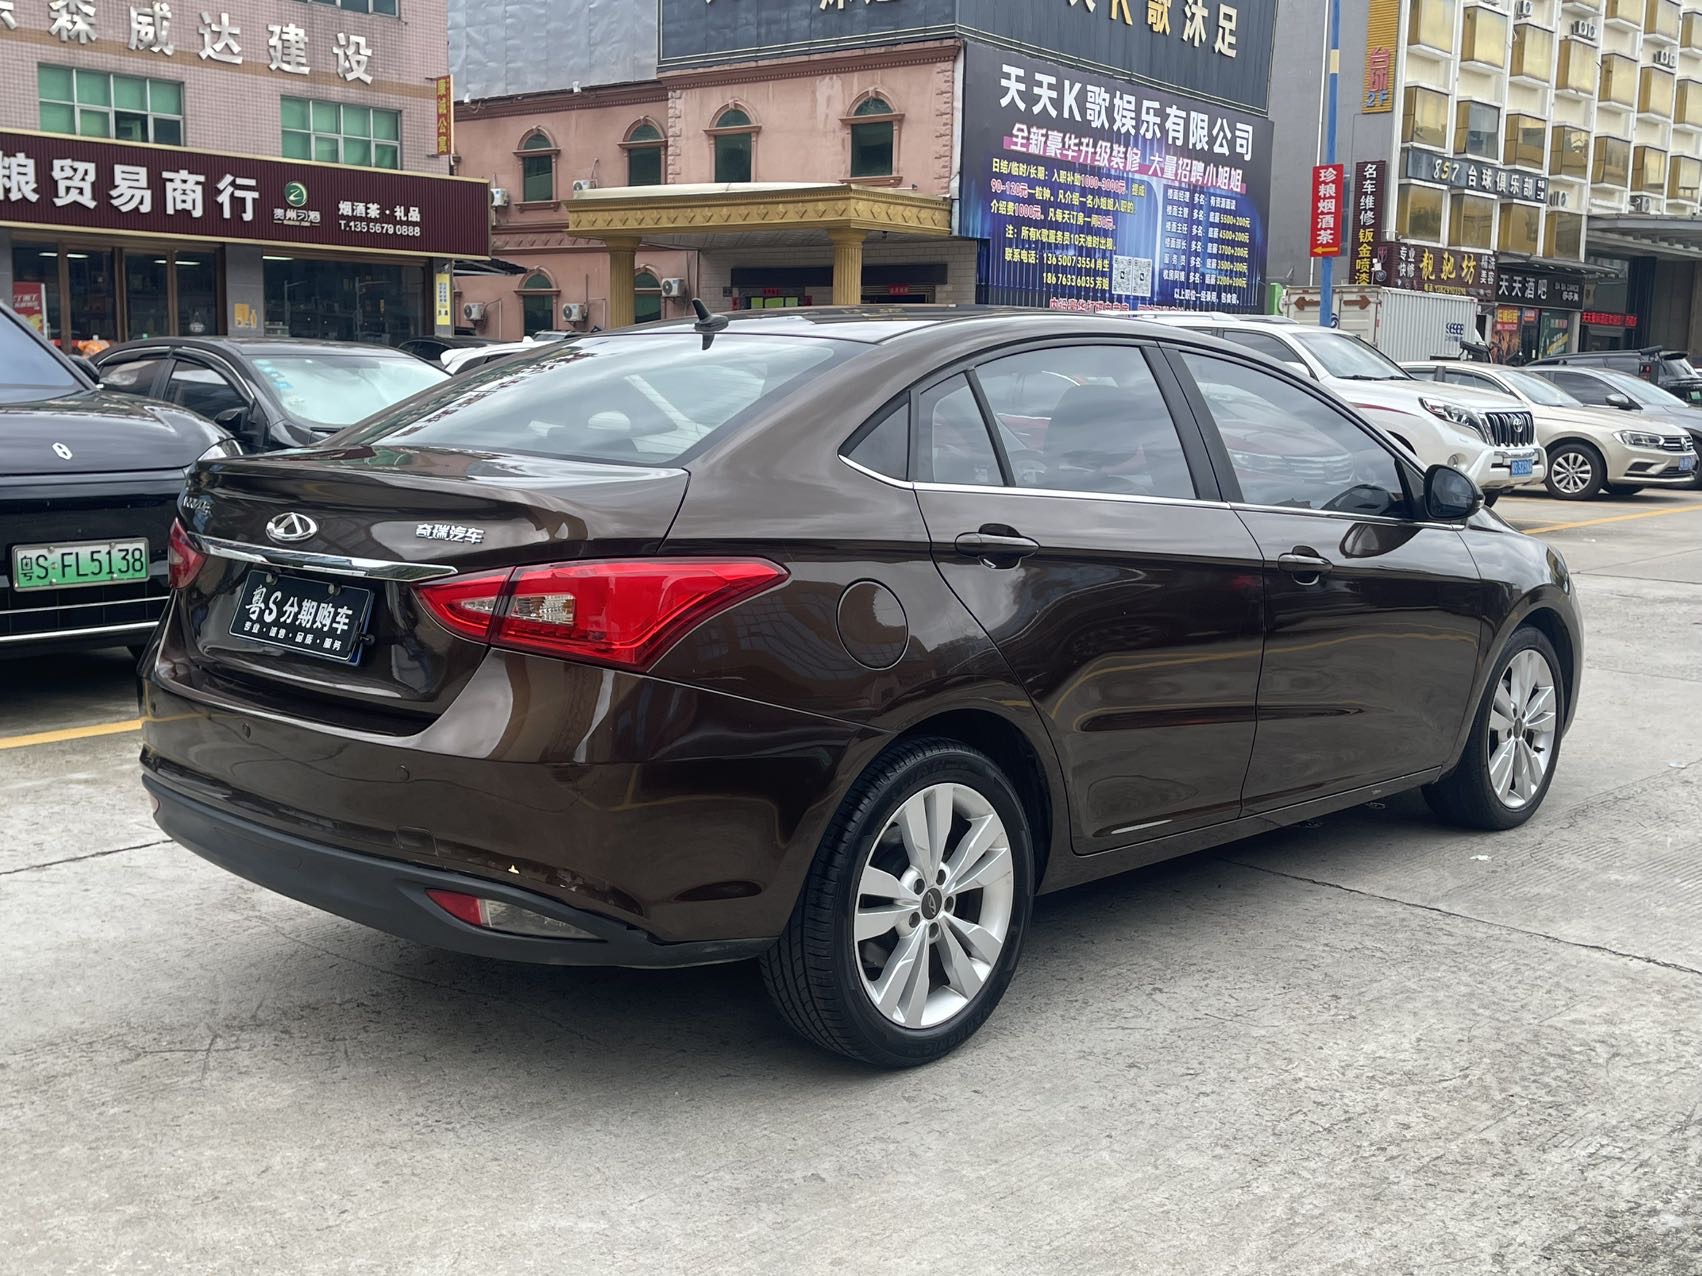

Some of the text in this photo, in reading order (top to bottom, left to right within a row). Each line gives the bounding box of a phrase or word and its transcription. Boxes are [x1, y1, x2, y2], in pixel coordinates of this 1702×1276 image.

[0, 0, 373, 84] 森威达建设
[1000, 64, 1253, 161] 天天K歌娱乐有限公司
[0, 152, 260, 221] 粮贸易商行
[1011, 123, 1243, 192] 全新豪华升级装修 大量招聘小姐姐
[1433, 160, 1533, 197] 857 台球俱乐部
[1317, 168, 1337, 244] 珍粮烟酒茶
[1498, 275, 1547, 299] 天天酒吧
[416, 523, 485, 544] 奇瑞汽车
